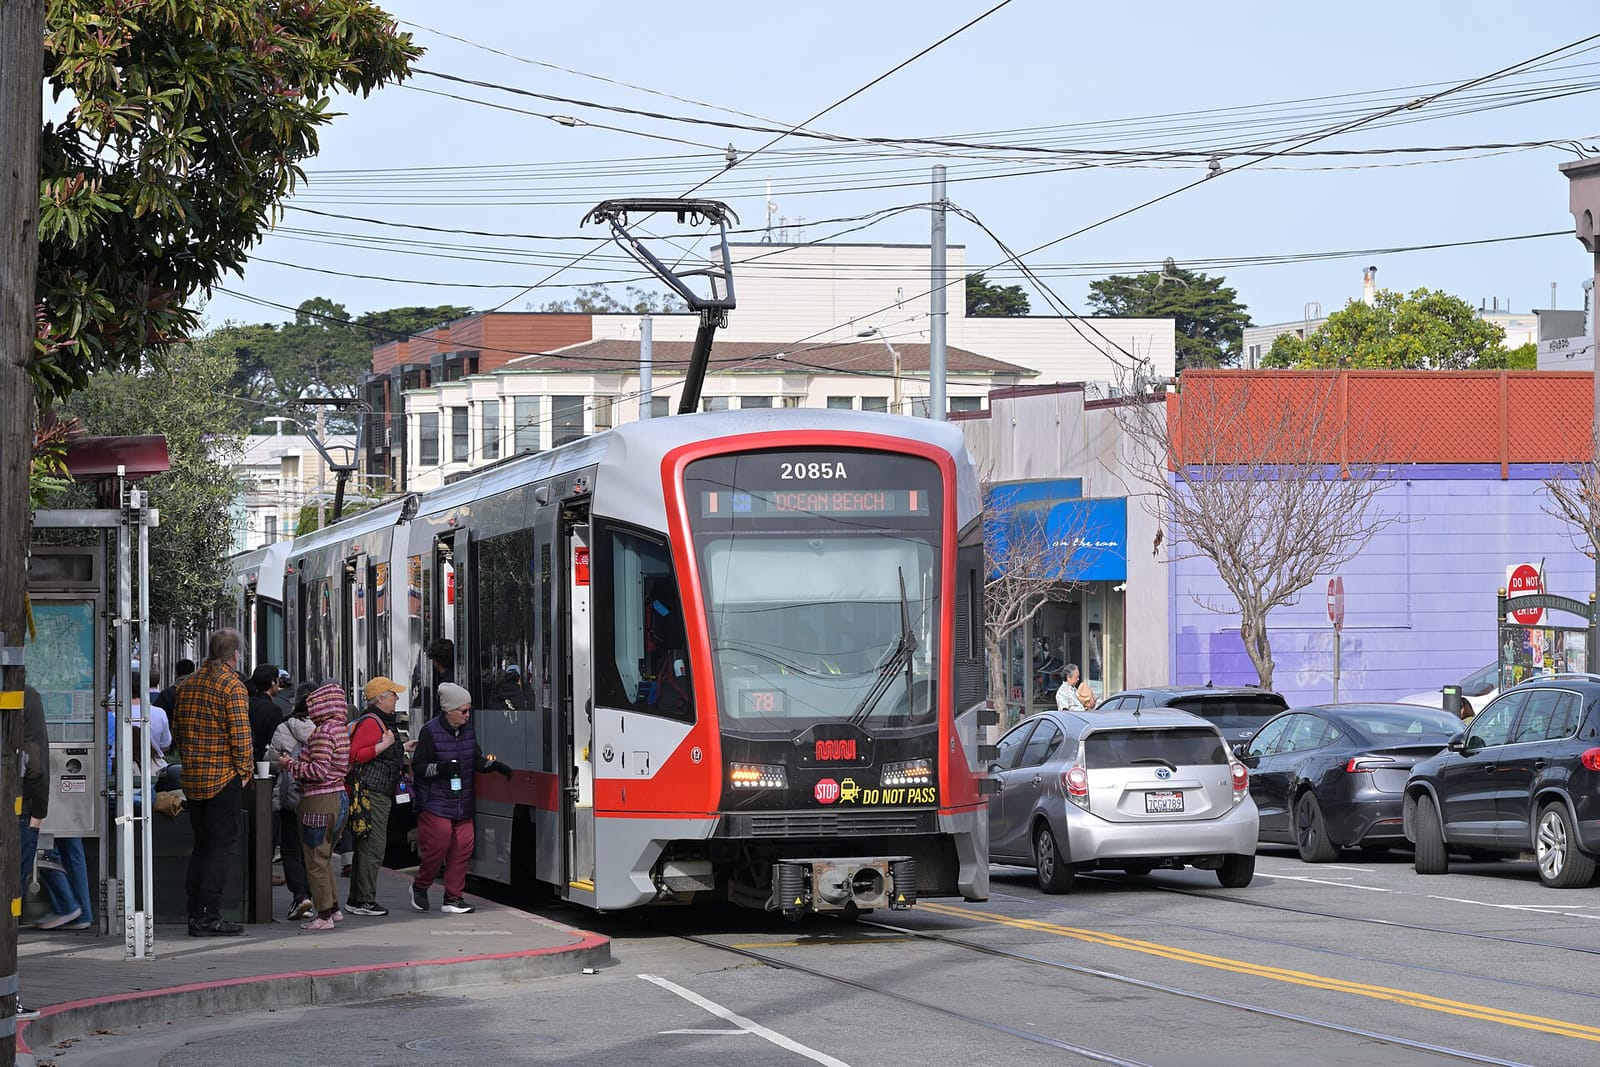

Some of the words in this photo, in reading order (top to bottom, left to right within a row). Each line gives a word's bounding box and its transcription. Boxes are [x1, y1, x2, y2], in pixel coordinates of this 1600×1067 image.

[780, 462, 848, 480] 2085A
[776, 492, 828, 511] OCEAN
[833, 491, 885, 511] BEACH
[1512, 577, 1522, 588] DO
[1526, 576, 1539, 587] NOT
[753, 692, 775, 712] 78
[816, 784, 838, 800] STOP
[862, 789, 880, 805] DO
[882, 788, 906, 804] NOT
[907, 787, 936, 804] PASS
[1148, 799, 1182, 809] 7CGW789
